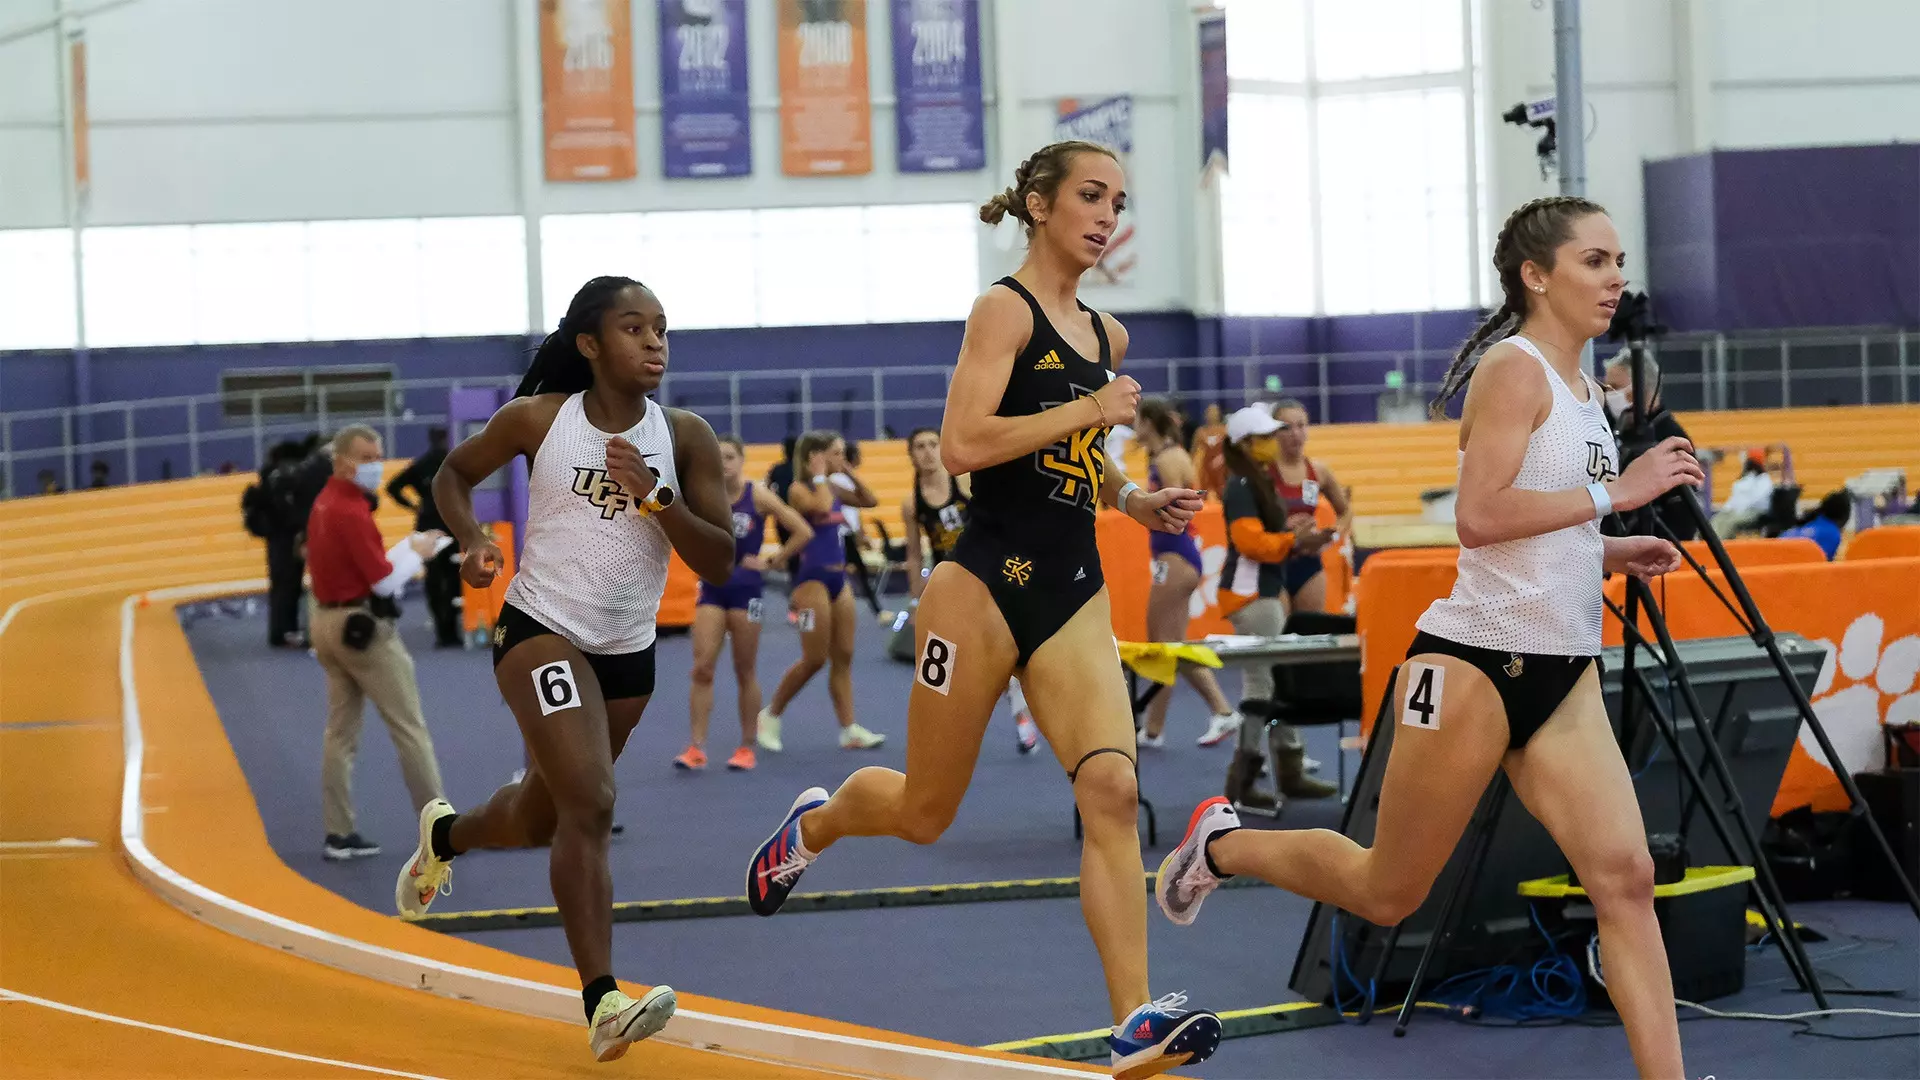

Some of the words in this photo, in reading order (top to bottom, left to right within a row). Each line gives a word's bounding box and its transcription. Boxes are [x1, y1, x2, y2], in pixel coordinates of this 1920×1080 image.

[1034, 362, 1065, 370] adidas
[572, 467, 629, 520] UCF
[539, 665, 573, 707] 6
[922, 638, 949, 688] 8
[1408, 667, 1434, 725] 4
